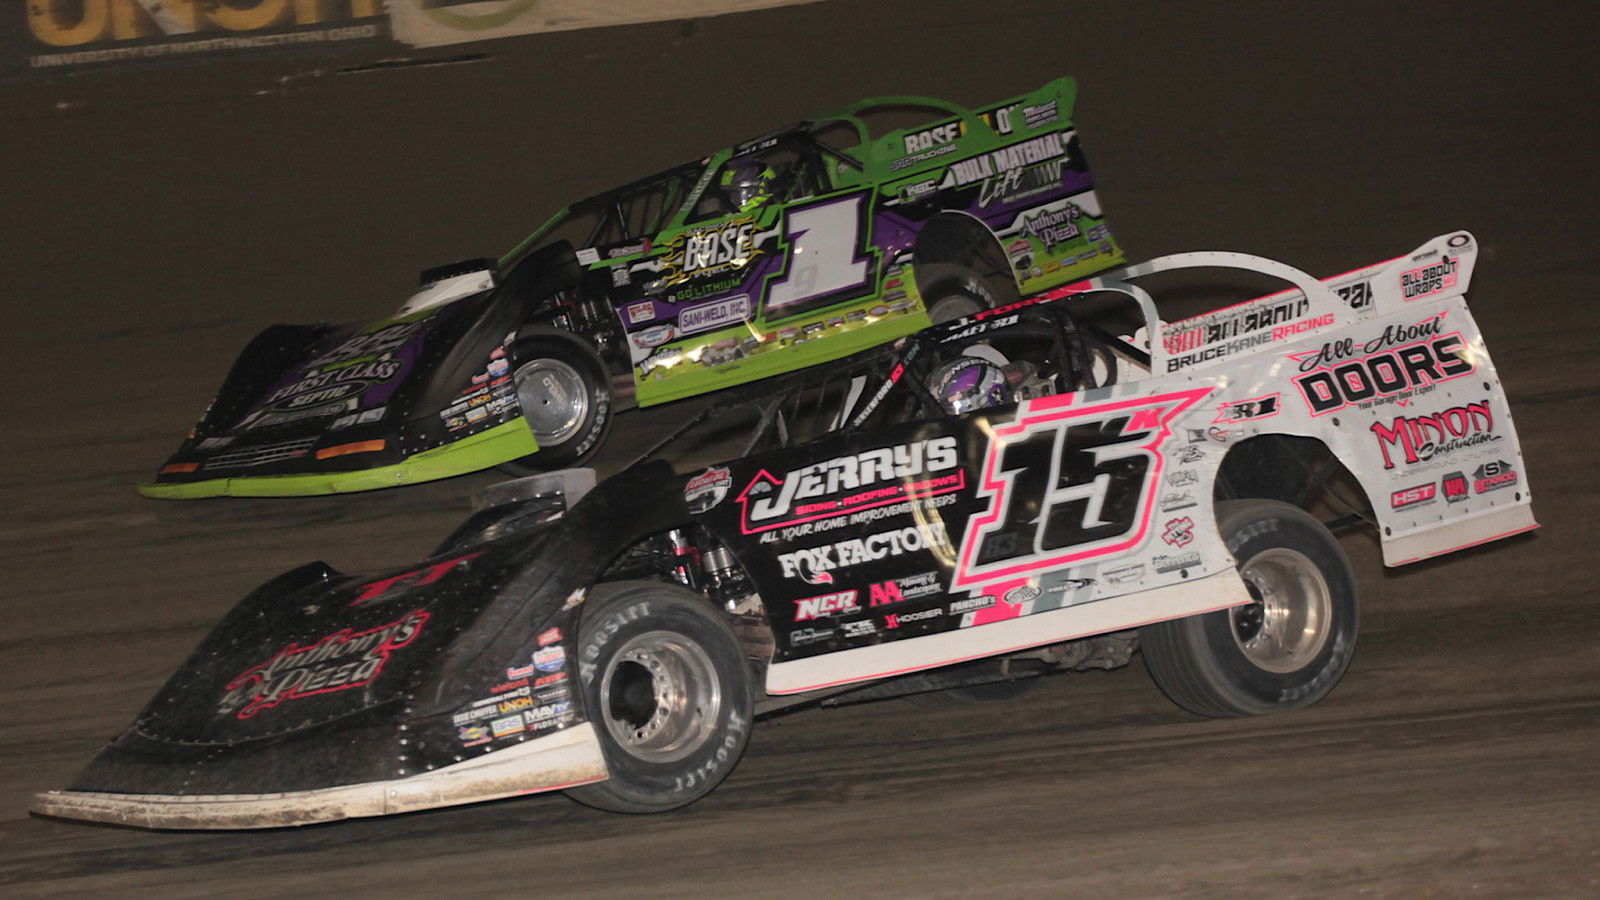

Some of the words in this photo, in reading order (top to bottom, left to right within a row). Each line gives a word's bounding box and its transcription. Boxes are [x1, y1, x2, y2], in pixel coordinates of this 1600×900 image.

[951, 153, 993, 187] BULK
[993, 132, 1066, 173] MATERIAL
[1022, 202, 1081, 237] Anthony's
[1040, 224, 1080, 250] Pizza
[683, 223, 755, 273] BASE
[764, 196, 870, 311] 1
[1298, 337, 1354, 373] All
[1363, 315, 1446, 355] About
[336, 361, 402, 381] CLASS
[1298, 335, 1477, 413] DOORS
[1124, 406, 1168, 432] K
[1370, 400, 1494, 470] MINON
[1416, 430, 1503, 462] Construction
[750, 435, 959, 522] JERRY'S
[976, 414, 1164, 567] 15
[1392, 483, 1433, 507] HST
[760, 531, 778, 545] ALL
[781, 524, 813, 542] YOUR
[814, 515, 849, 534] HOME
[778, 549, 837, 586] FOX
[835, 521, 947, 567] FACTORY
[796, 589, 858, 622] NCR
[577, 600, 650, 688] HOOSIER
[498, 696, 533, 713] UNOH
[673, 708, 747, 793] HOOSIER
